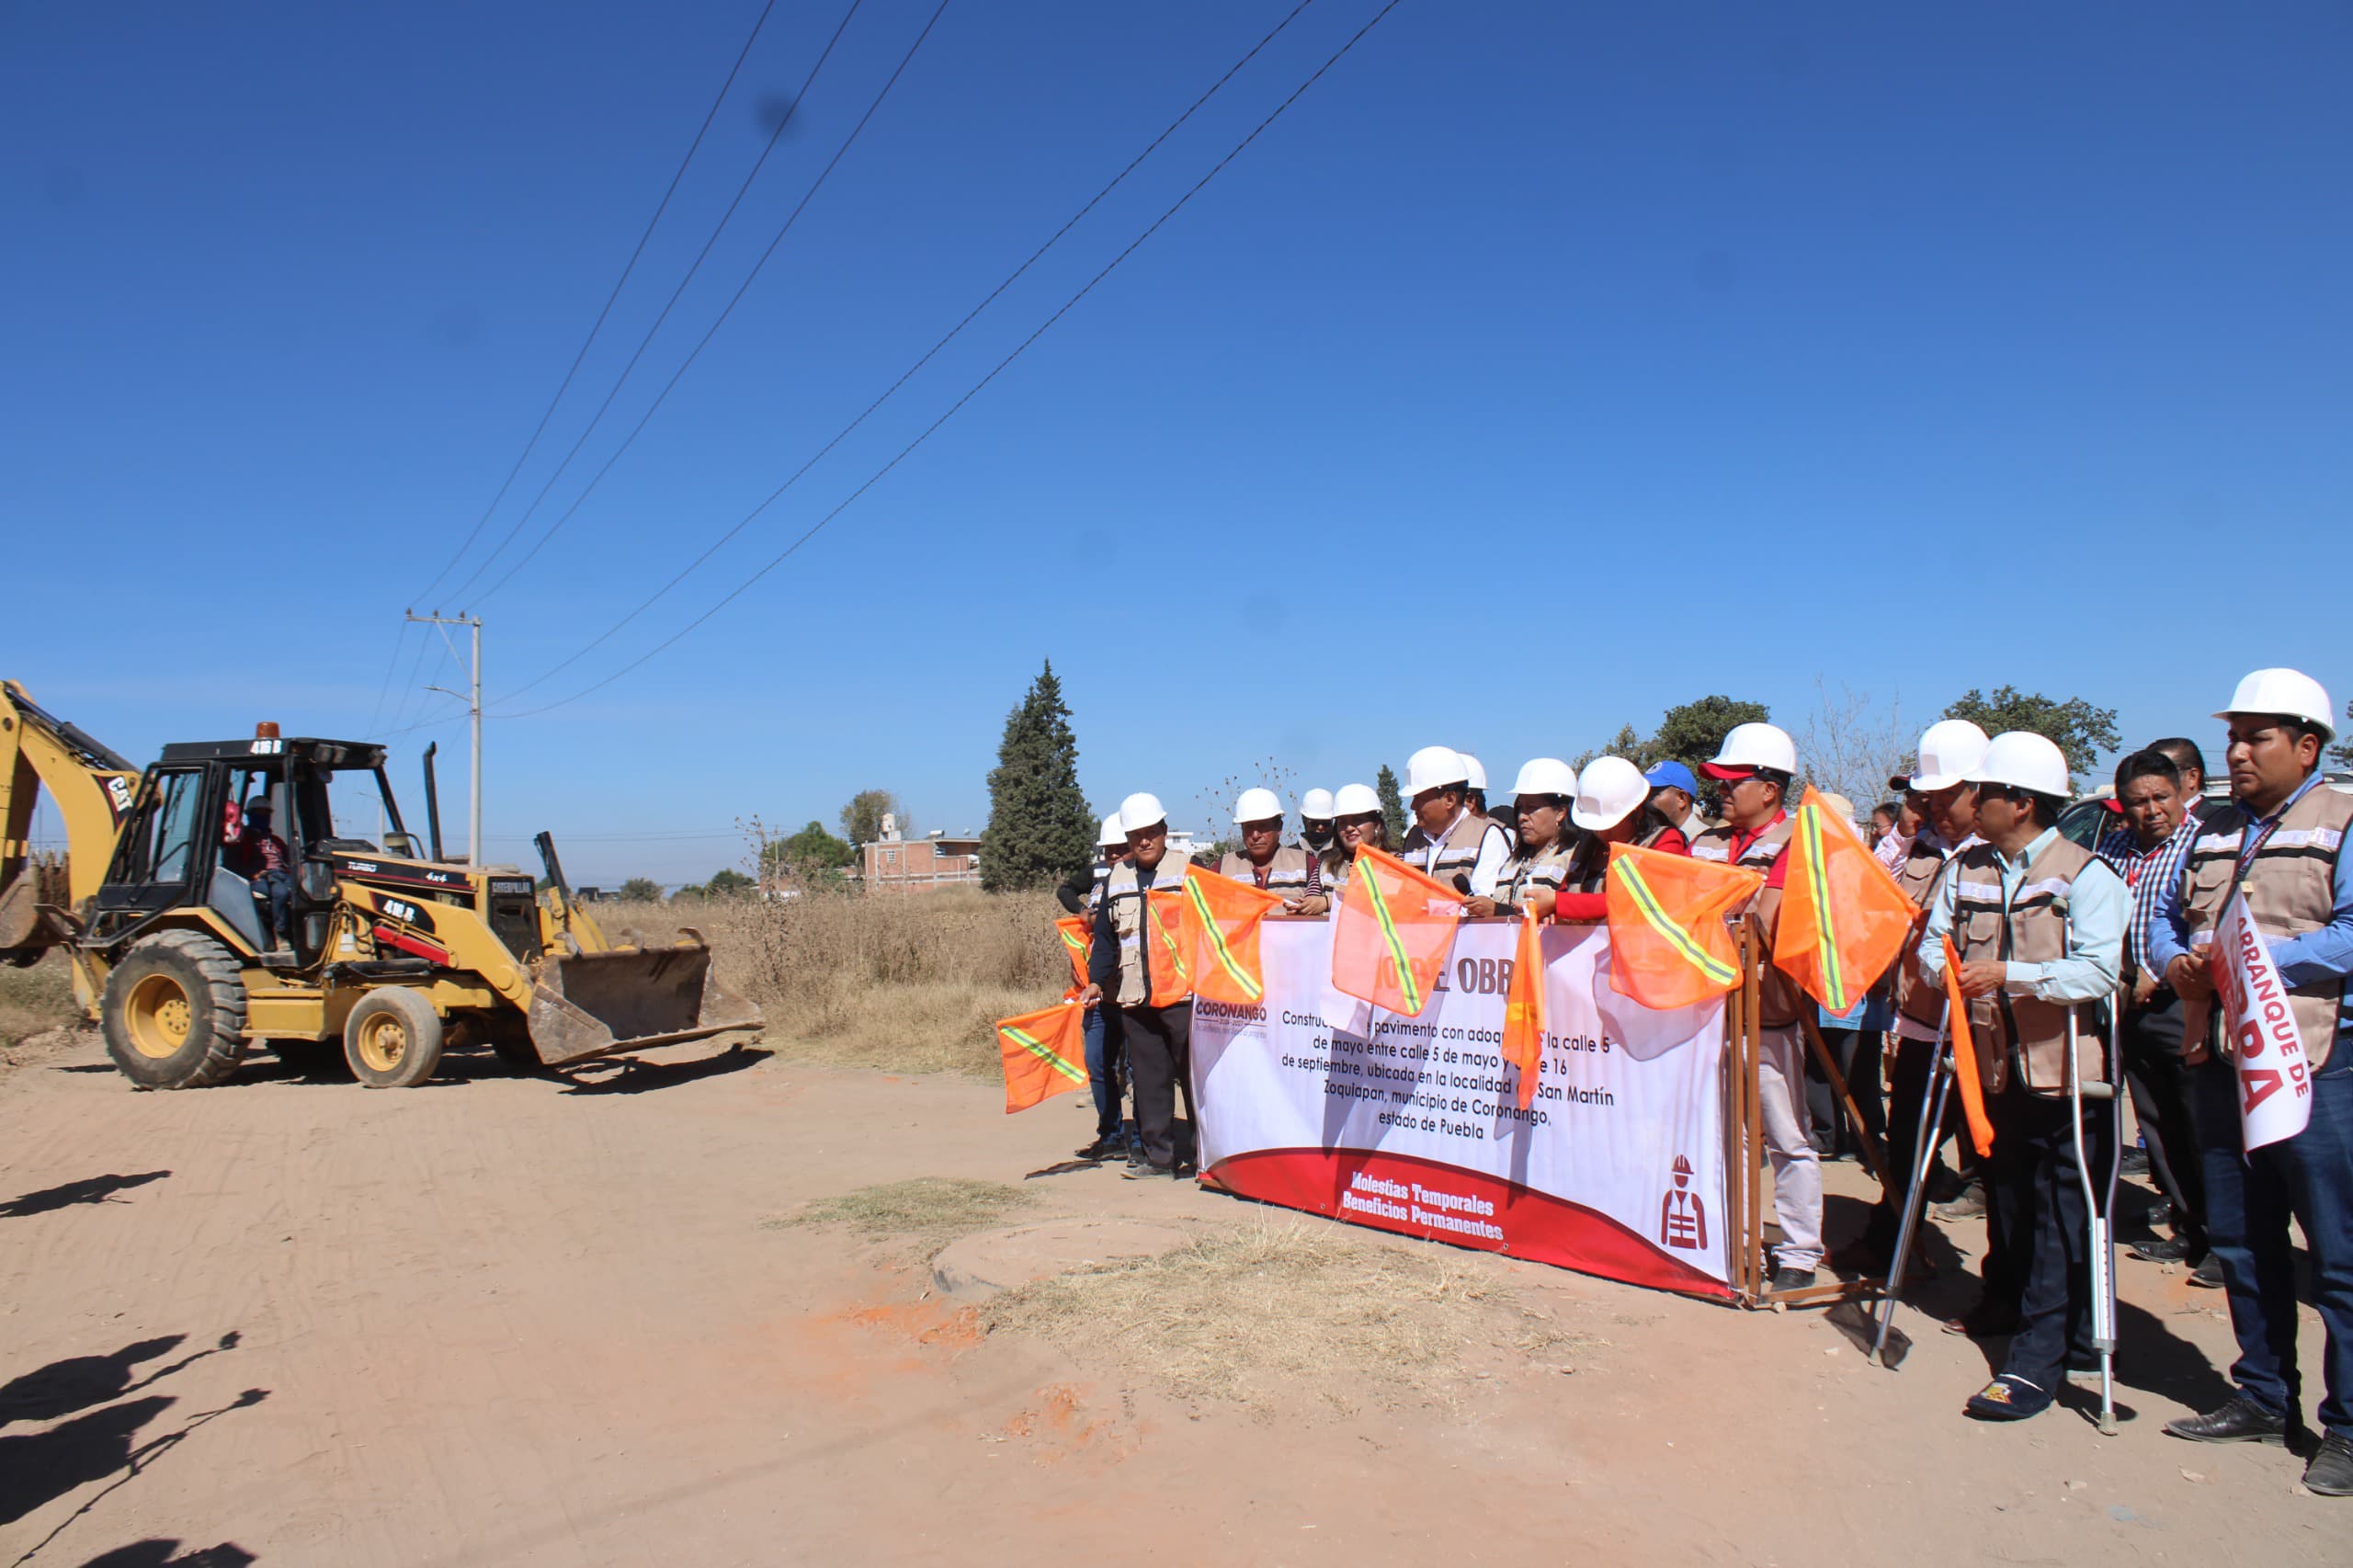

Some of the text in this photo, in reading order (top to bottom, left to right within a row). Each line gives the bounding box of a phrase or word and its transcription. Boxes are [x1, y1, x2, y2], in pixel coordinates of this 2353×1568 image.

[108, 776, 133, 812] CAT
[348, 861, 377, 872] TURBO
[426, 871, 448, 882] 4x4
[1457, 958, 1516, 994] OBR
[1196, 1001, 1267, 1021] CORONANGO
[2238, 917, 2309, 1098] ARRANQUE DE
[1375, 1020, 1438, 1038] pavimento
[1441, 1027, 1463, 1040] con
[1547, 1032, 1558, 1049] la
[1563, 1034, 1597, 1052] calle
[1602, 1037, 1610, 1053] 5
[1313, 1035, 1327, 1050] de
[1332, 1040, 1363, 1056] mayo
[1368, 1042, 1396, 1058] entre
[1401, 1044, 1429, 1061] calle
[1433, 1047, 1439, 1062] 5
[1443, 1048, 1458, 1063] de
[1462, 1052, 1498, 1071] mayo
[1503, 1057, 1509, 1073] y
[1553, 1058, 1567, 1075] 16
[1282, 1052, 1295, 1067] de
[1298, 1057, 1364, 1077] septiembre,
[1368, 1063, 1415, 1082] ubicada
[1418, 1073, 1432, 1085] en
[1436, 1071, 1446, 1086] la
[1449, 1071, 1512, 1094] localidad
[1537, 1081, 1563, 1100] San
[1567, 1085, 1614, 1106] Martín
[1324, 1079, 1551, 1126] Zoquiapan, municipio de Coronango,
[1379, 1112, 1483, 1140] estado de Puebla
[1351, 1171, 1495, 1216] Molestias Temporales
[1342, 1191, 1504, 1241] Beneficios Permanentes
